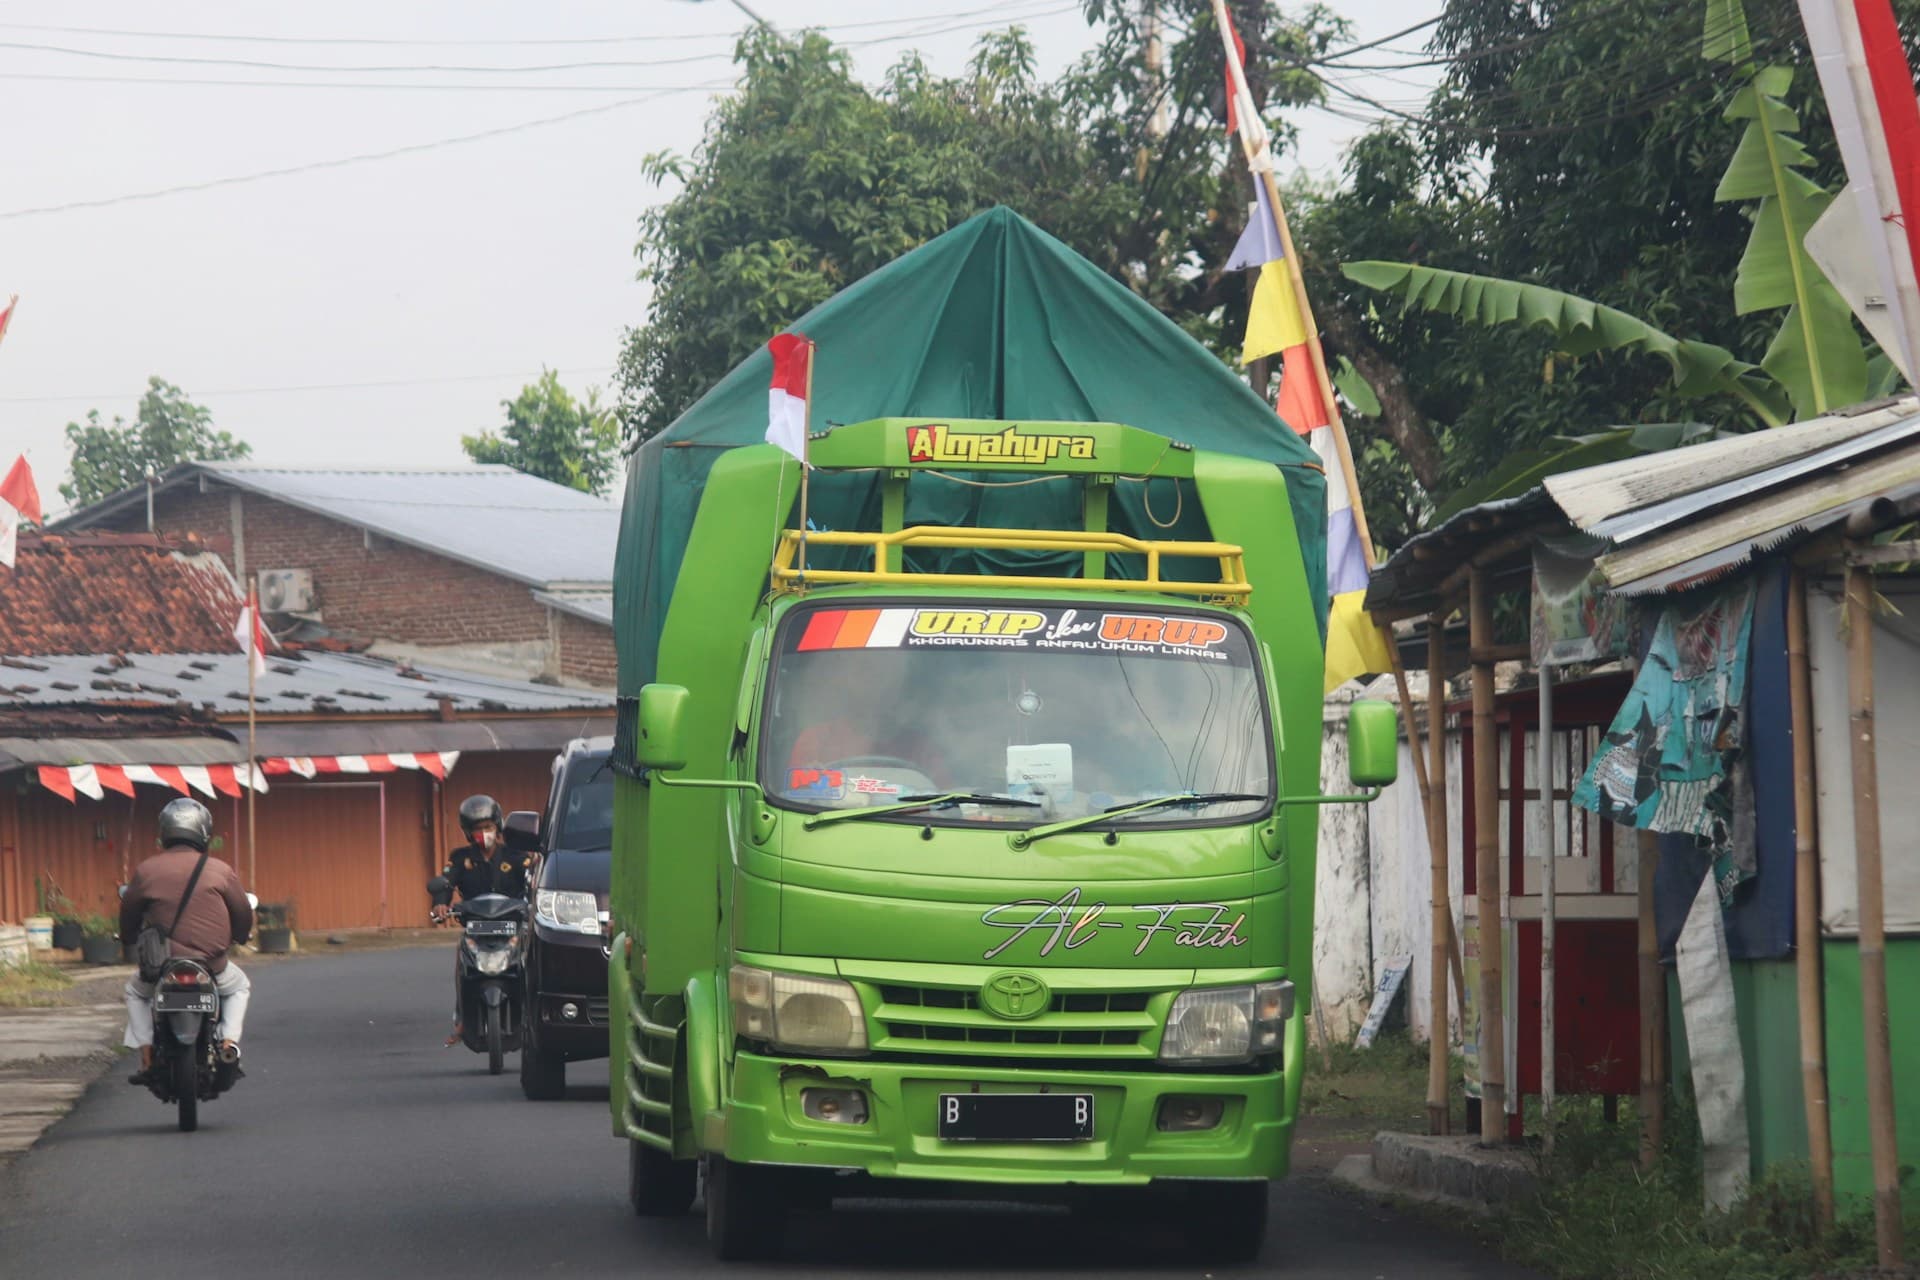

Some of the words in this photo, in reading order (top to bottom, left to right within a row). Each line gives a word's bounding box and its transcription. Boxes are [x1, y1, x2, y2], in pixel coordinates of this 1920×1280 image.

[907, 424, 1096, 464] Almahyra
[910, 609, 1047, 637] URIP
[1045, 609, 1096, 640] iku
[1098, 614, 1227, 649] URUP
[908, 637, 1028, 647] KHOIRUNNAS
[1161, 646, 1228, 660] LINNAS
[946, 1096, 960, 1124] B
[1075, 1097, 1088, 1125] B
